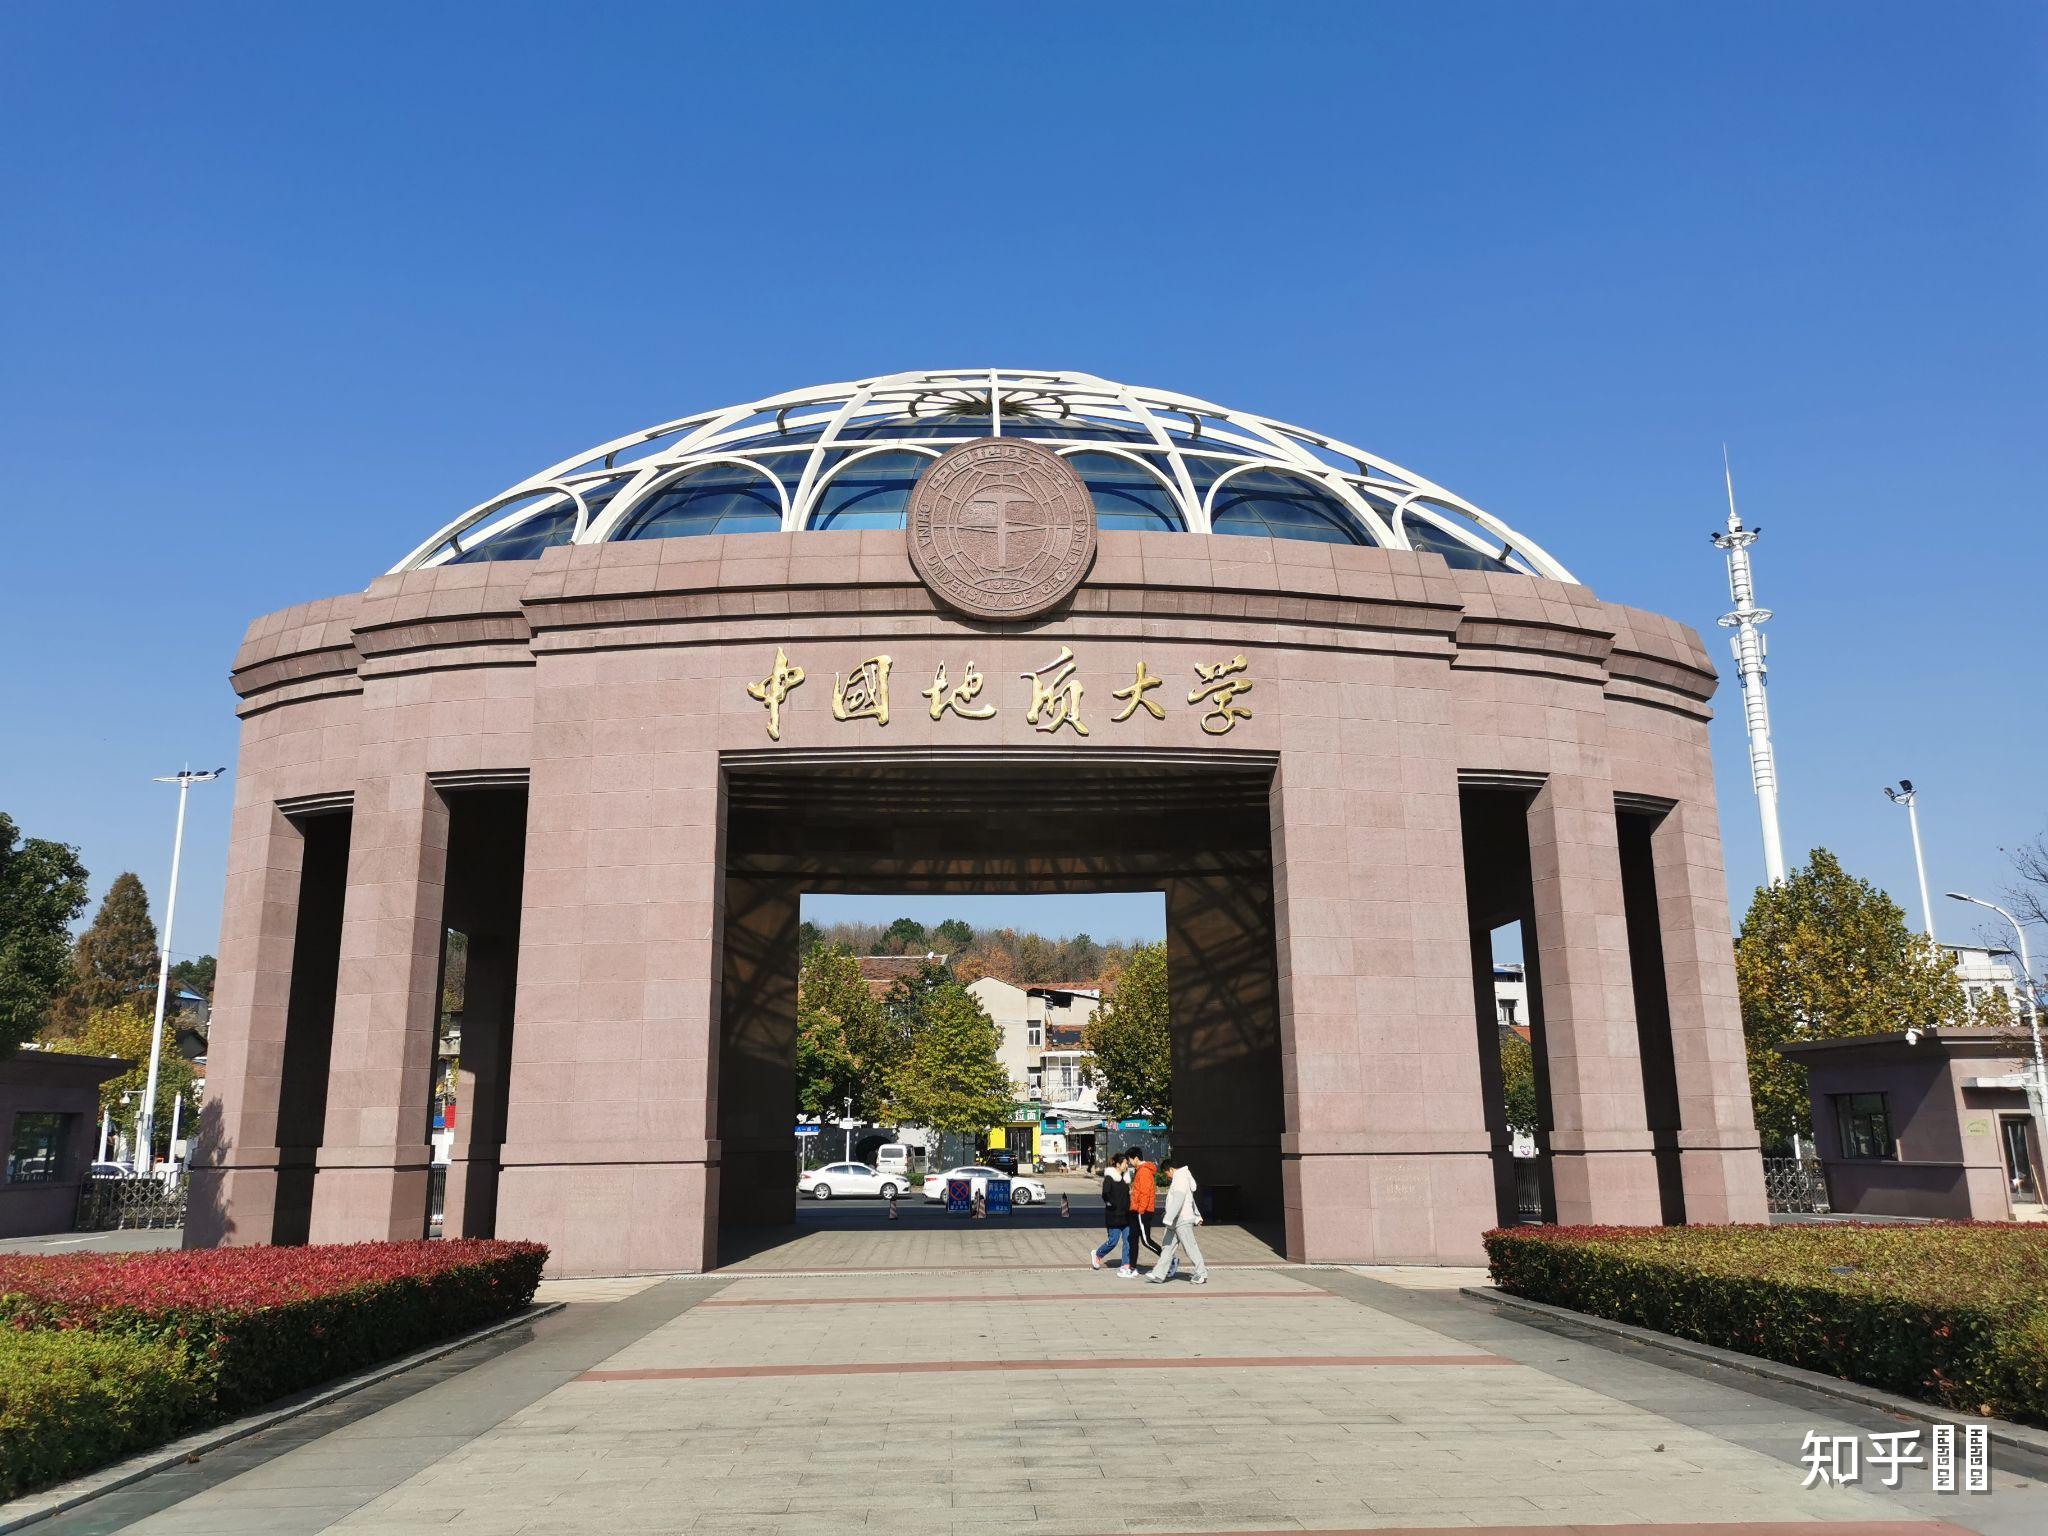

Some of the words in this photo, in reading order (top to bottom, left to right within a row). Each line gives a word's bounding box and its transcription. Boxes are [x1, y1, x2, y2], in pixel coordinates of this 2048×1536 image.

[917, 503, 931, 549] CHINA
[927, 554, 1003, 608] UNIVERSITY
[1012, 591, 1034, 606] OF
[1040, 503, 1088, 594] GEOSCIENCES
[984, 581, 1022, 591] 1952
